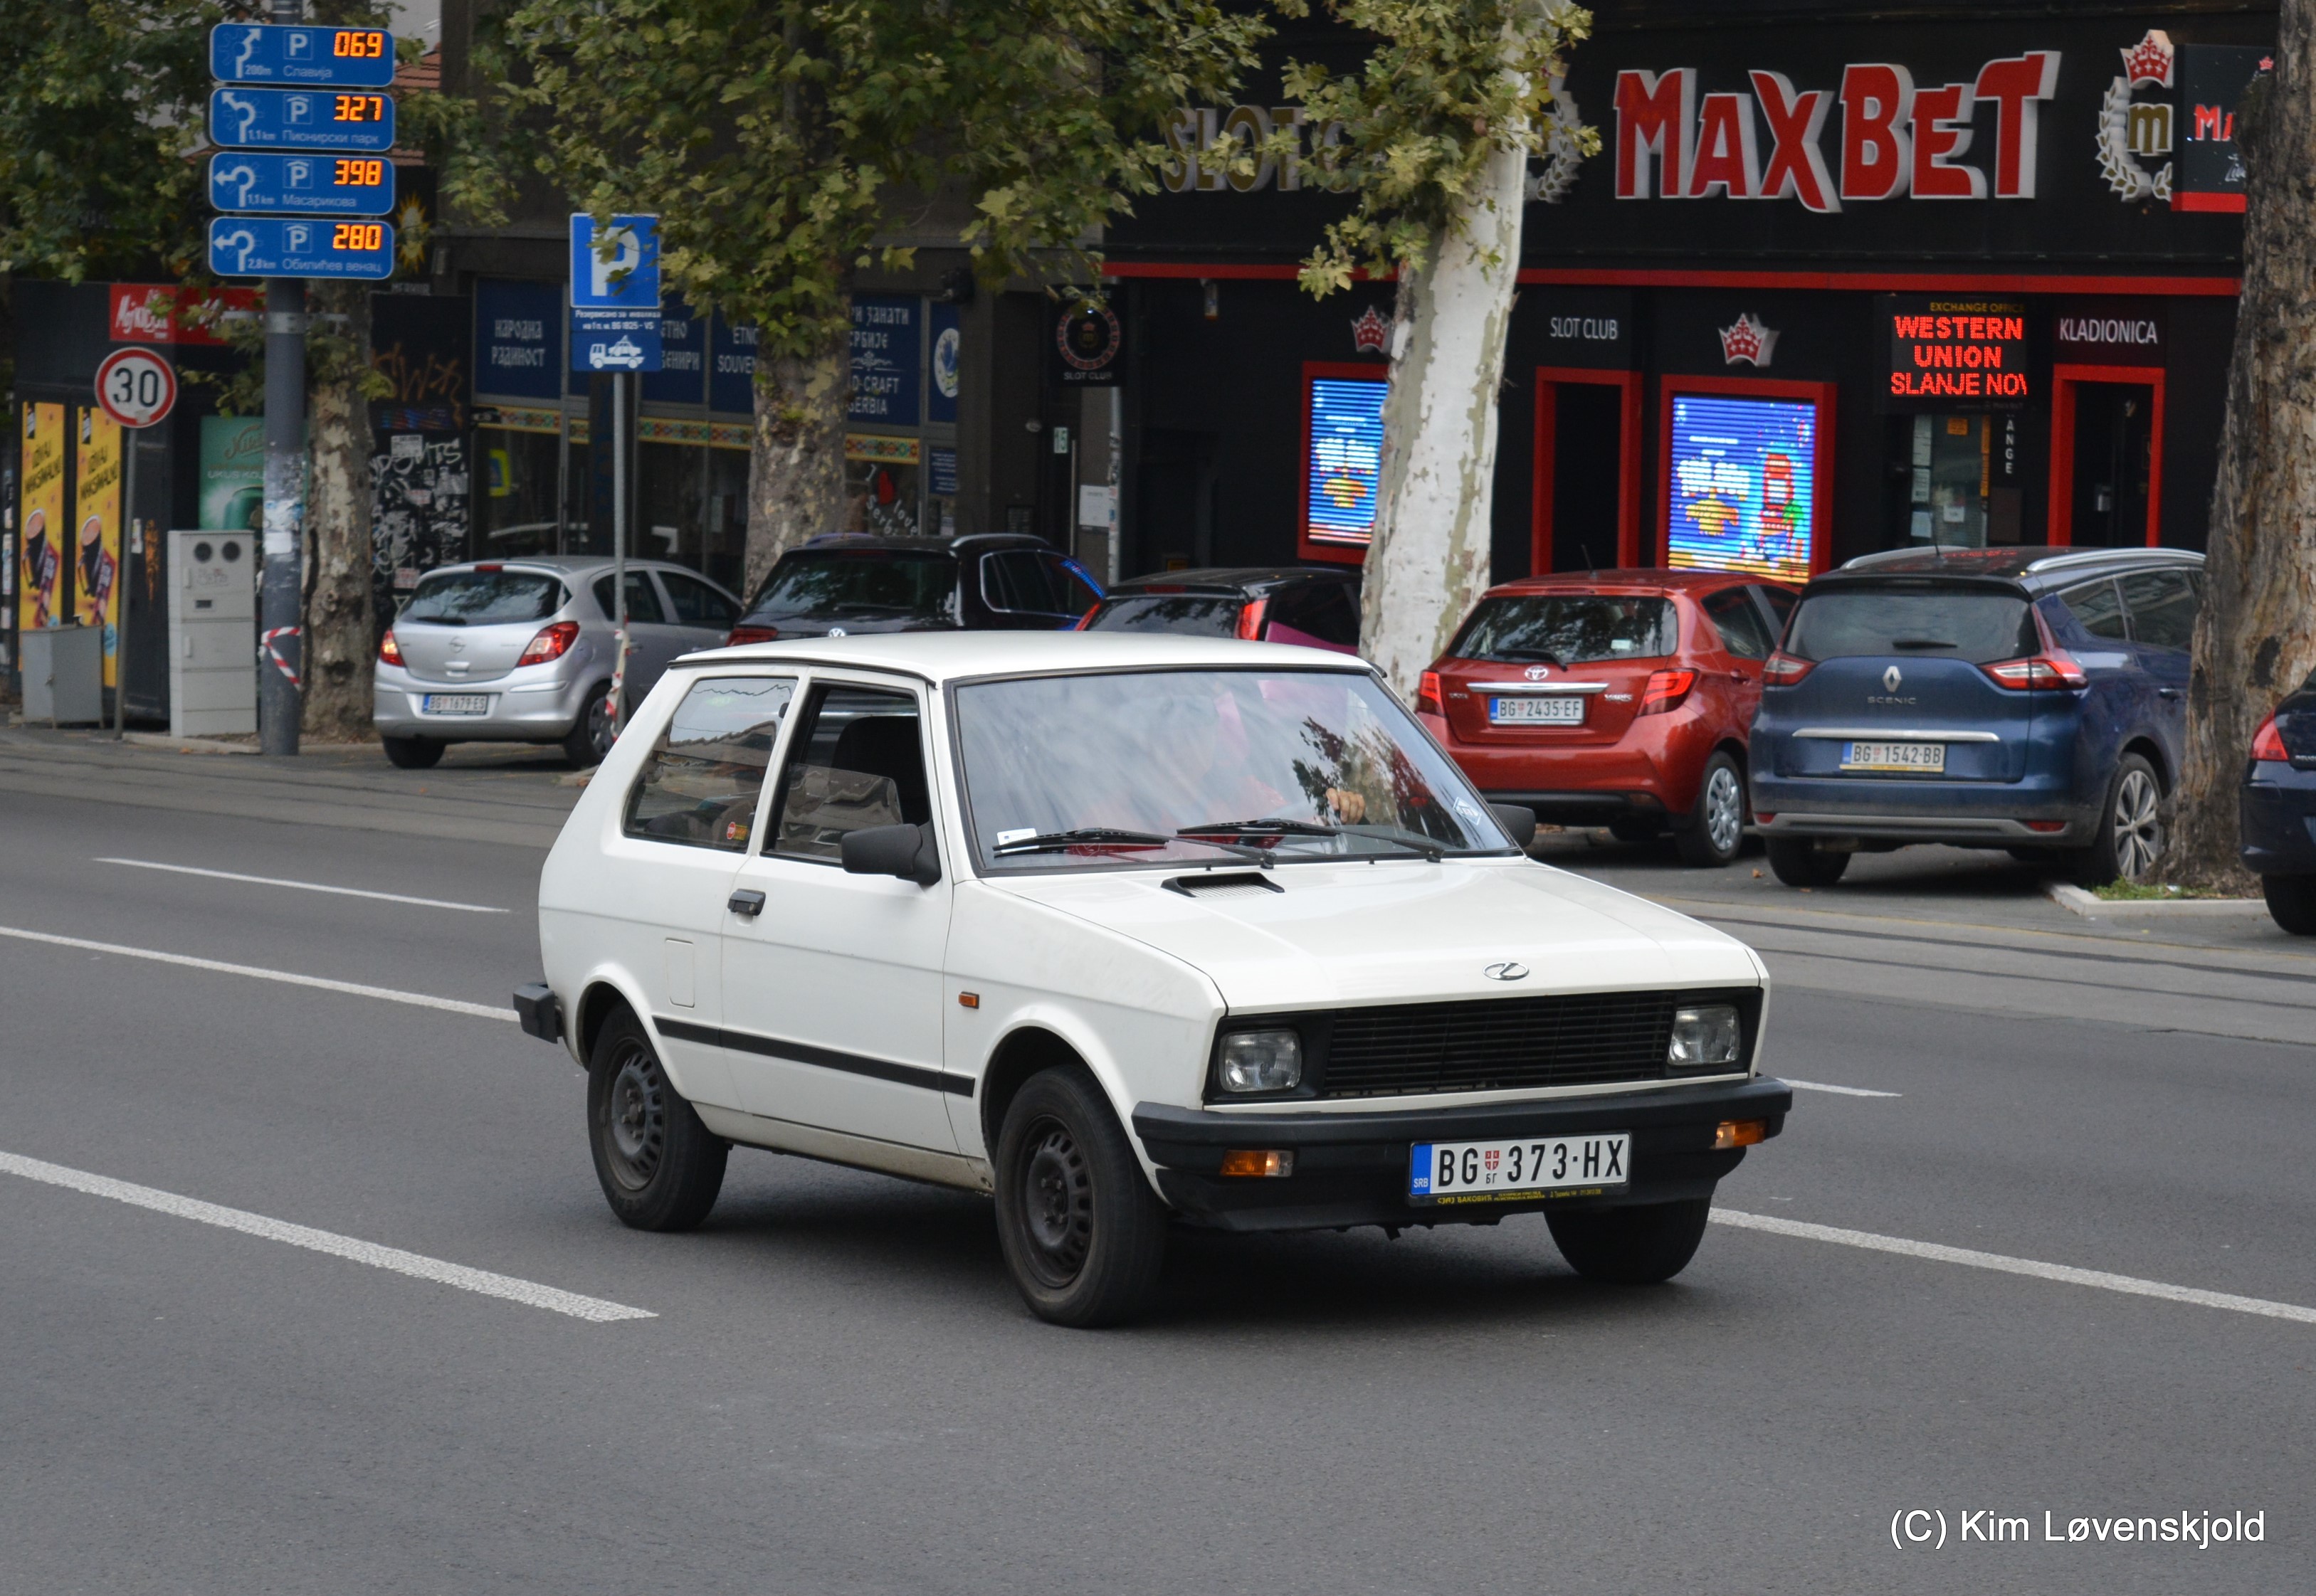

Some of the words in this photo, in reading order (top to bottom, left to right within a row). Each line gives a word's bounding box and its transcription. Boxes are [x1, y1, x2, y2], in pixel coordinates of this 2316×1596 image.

[333, 31, 384, 58] 069
[283, 65, 333, 80] Славија
[334, 95, 384, 121] 327
[283, 130, 348, 144] Пионирски
[351, 134, 379, 145] парк
[1614, 50, 2062, 213] MAXBET
[334, 160, 383, 186] 398
[283, 194, 357, 208] Масарикова
[332, 224, 382, 250] 280
[283, 258, 343, 271] Обилићев
[346, 261, 381, 273] венац
[1930, 302, 1987, 312] EXCHANGE
[1989, 303, 2025, 313] OFFICE
[1549, 317, 1581, 338] SLOT
[1583, 319, 1618, 340] CLUB
[1894, 316, 2023, 339] WESTERN
[2060, 319, 2158, 344] KLADIONICA
[1914, 345, 2001, 369] UNION
[113, 368, 159, 408] 30
[1063, 372, 1087, 381] SLOT
[1891, 372, 1980, 395] SLANJE
[2005, 415, 2015, 475] ANGE
[1500, 702, 1515, 717] BG
[1853, 746, 1871, 762] BG
[1438, 1148, 1478, 1187] BG
[1414, 1178, 1428, 1188] SRB
